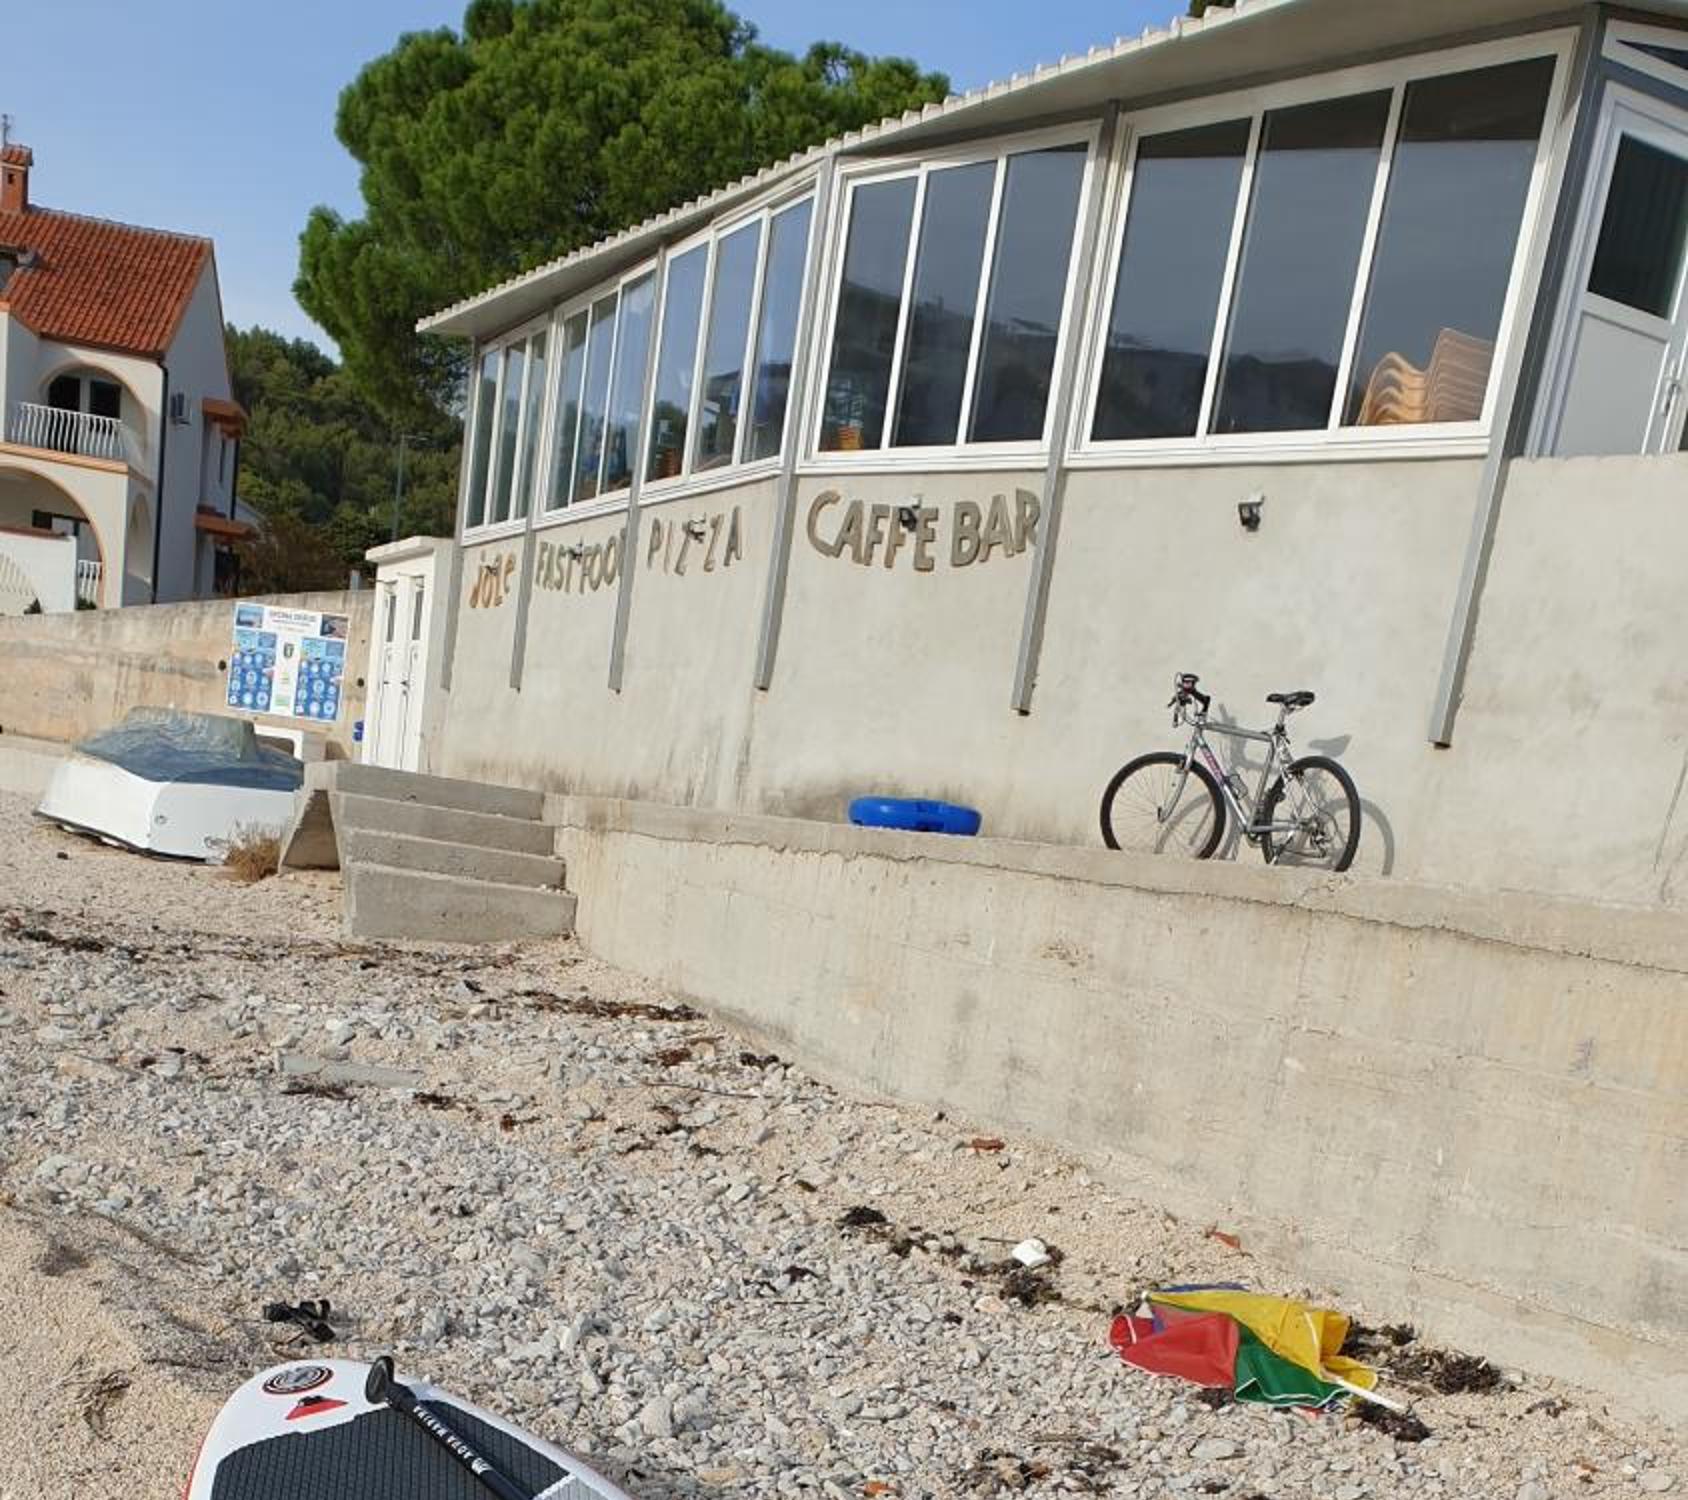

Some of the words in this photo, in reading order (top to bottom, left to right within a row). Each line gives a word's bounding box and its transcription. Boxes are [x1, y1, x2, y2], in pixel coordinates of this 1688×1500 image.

[535, 541, 574, 594] FAST
[579, 535, 624, 594] FOO
[647, 506, 743, 576] PIZZA
[807, 489, 939, 572] CAFFE
[951, 487, 1041, 567] BAR
